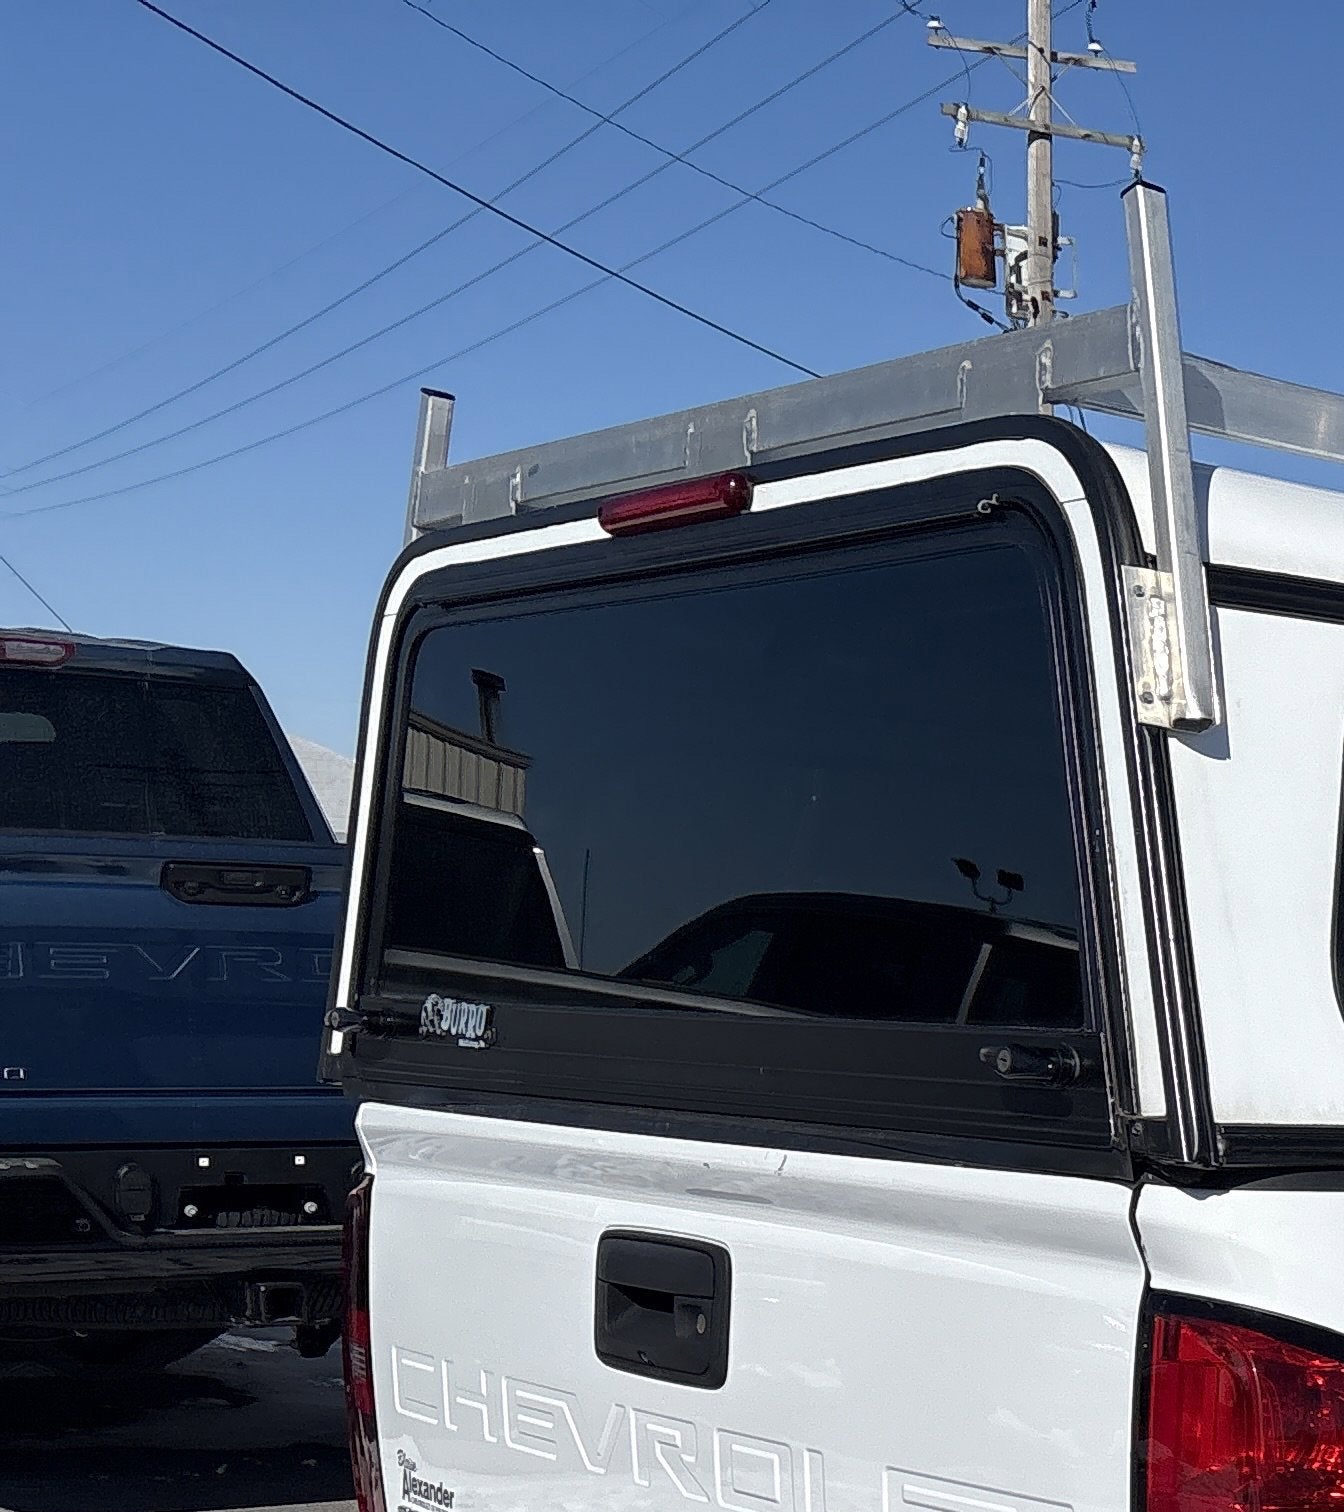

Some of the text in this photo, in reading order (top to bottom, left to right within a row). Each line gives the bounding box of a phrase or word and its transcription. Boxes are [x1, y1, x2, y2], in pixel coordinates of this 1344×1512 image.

[0, 941, 332, 983] EVR
[440, 997, 490, 1039] BURRO
[401, 1467, 455, 1509] Alexander
